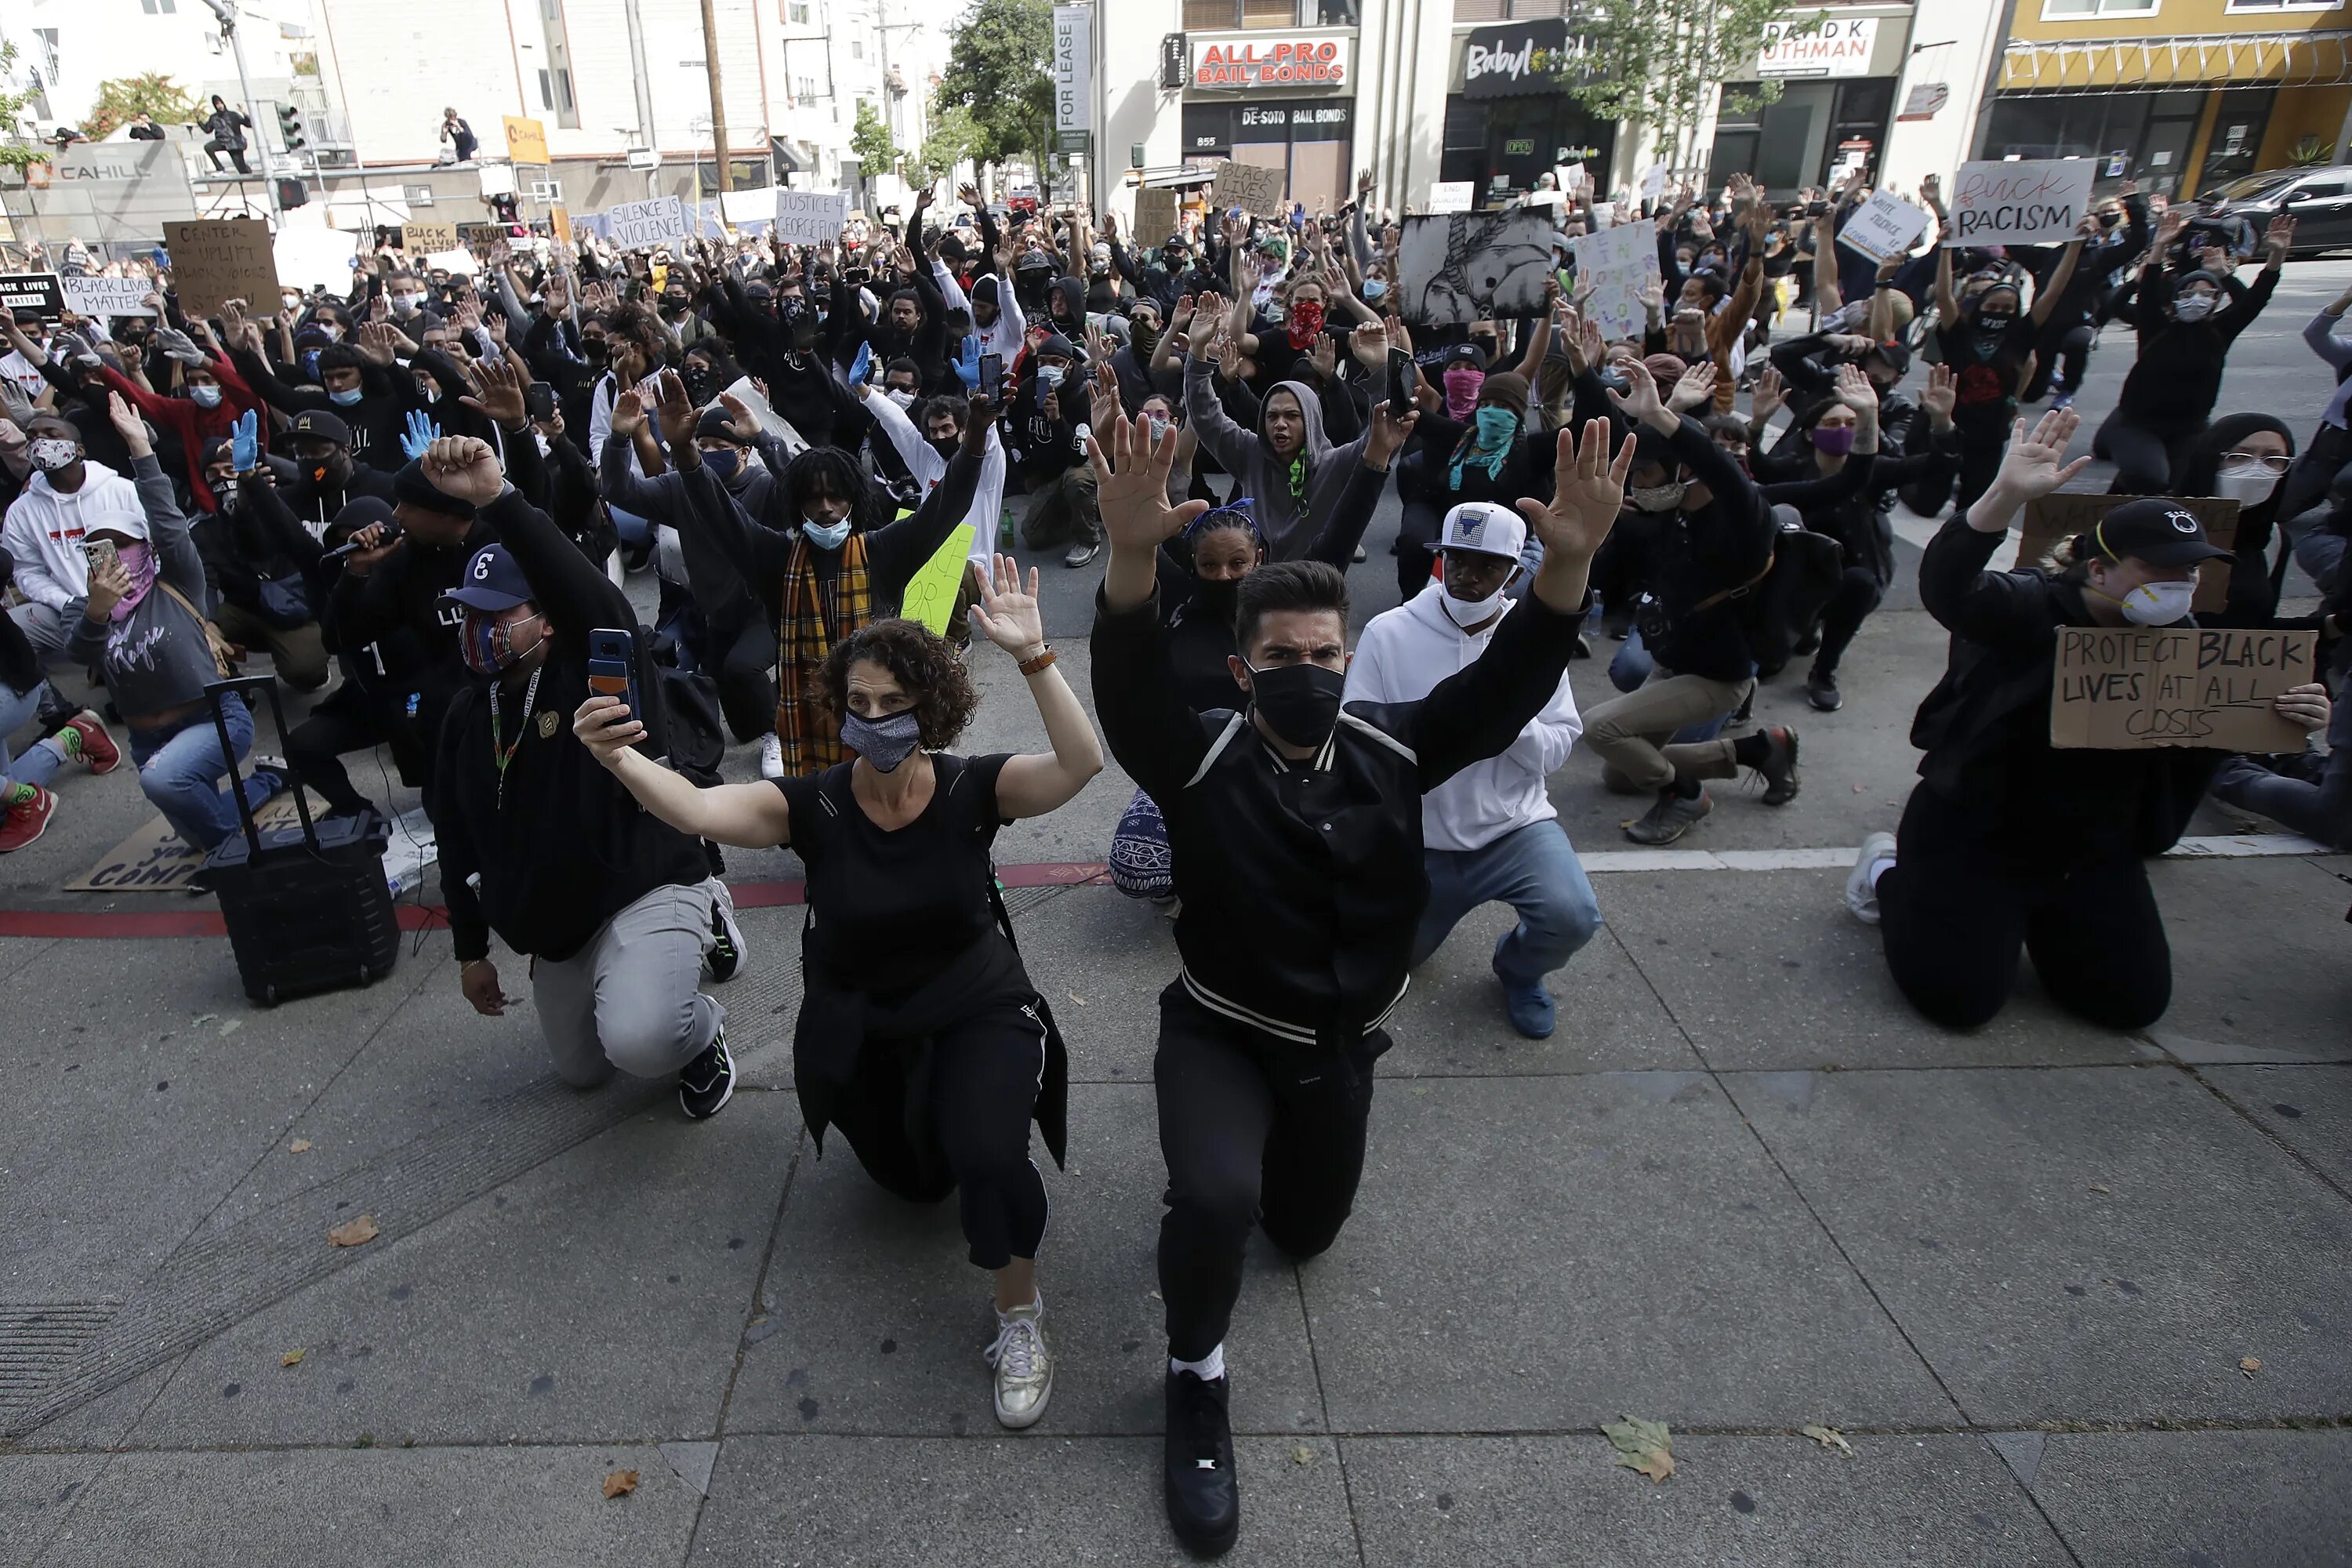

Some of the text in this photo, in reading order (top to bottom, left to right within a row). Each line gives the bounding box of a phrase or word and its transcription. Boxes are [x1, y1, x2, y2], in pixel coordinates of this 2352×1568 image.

[1059, 24, 1073, 84] LEASE
[1203, 42, 1338, 66] ALL-PRO
[1197, 64, 1344, 84] BAIL BONDS
[1061, 88, 1073, 125] FOR
[1243, 108, 1347, 125] DE-SOTO BAIL BONDS
[1196, 136, 1216, 147] 855
[1509, 142, 1531, 151] OPEN
[1222, 162, 1275, 183] BLACK
[1222, 180, 1269, 199] LIVES
[613, 198, 679, 224] SILENCE IS
[782, 194, 843, 216] JUSTICE 4
[1213, 193, 1274, 213] MATTER
[617, 216, 684, 244] VIOLENCE
[775, 216, 816, 239] GEORGE
[1959, 205, 2071, 237] RACISM
[24, 281, 50, 291] LIVES
[69, 278, 153, 293] BLACK LIVES
[6, 295, 42, 305] MATTER
[83, 294, 141, 312] MATTER
[191, 292, 255, 311] STU
[2063, 630, 2303, 670] PROTECT BLACK
[2063, 672, 2273, 705] LIVES AT ALL
[2125, 709, 2222, 736] COSTS
